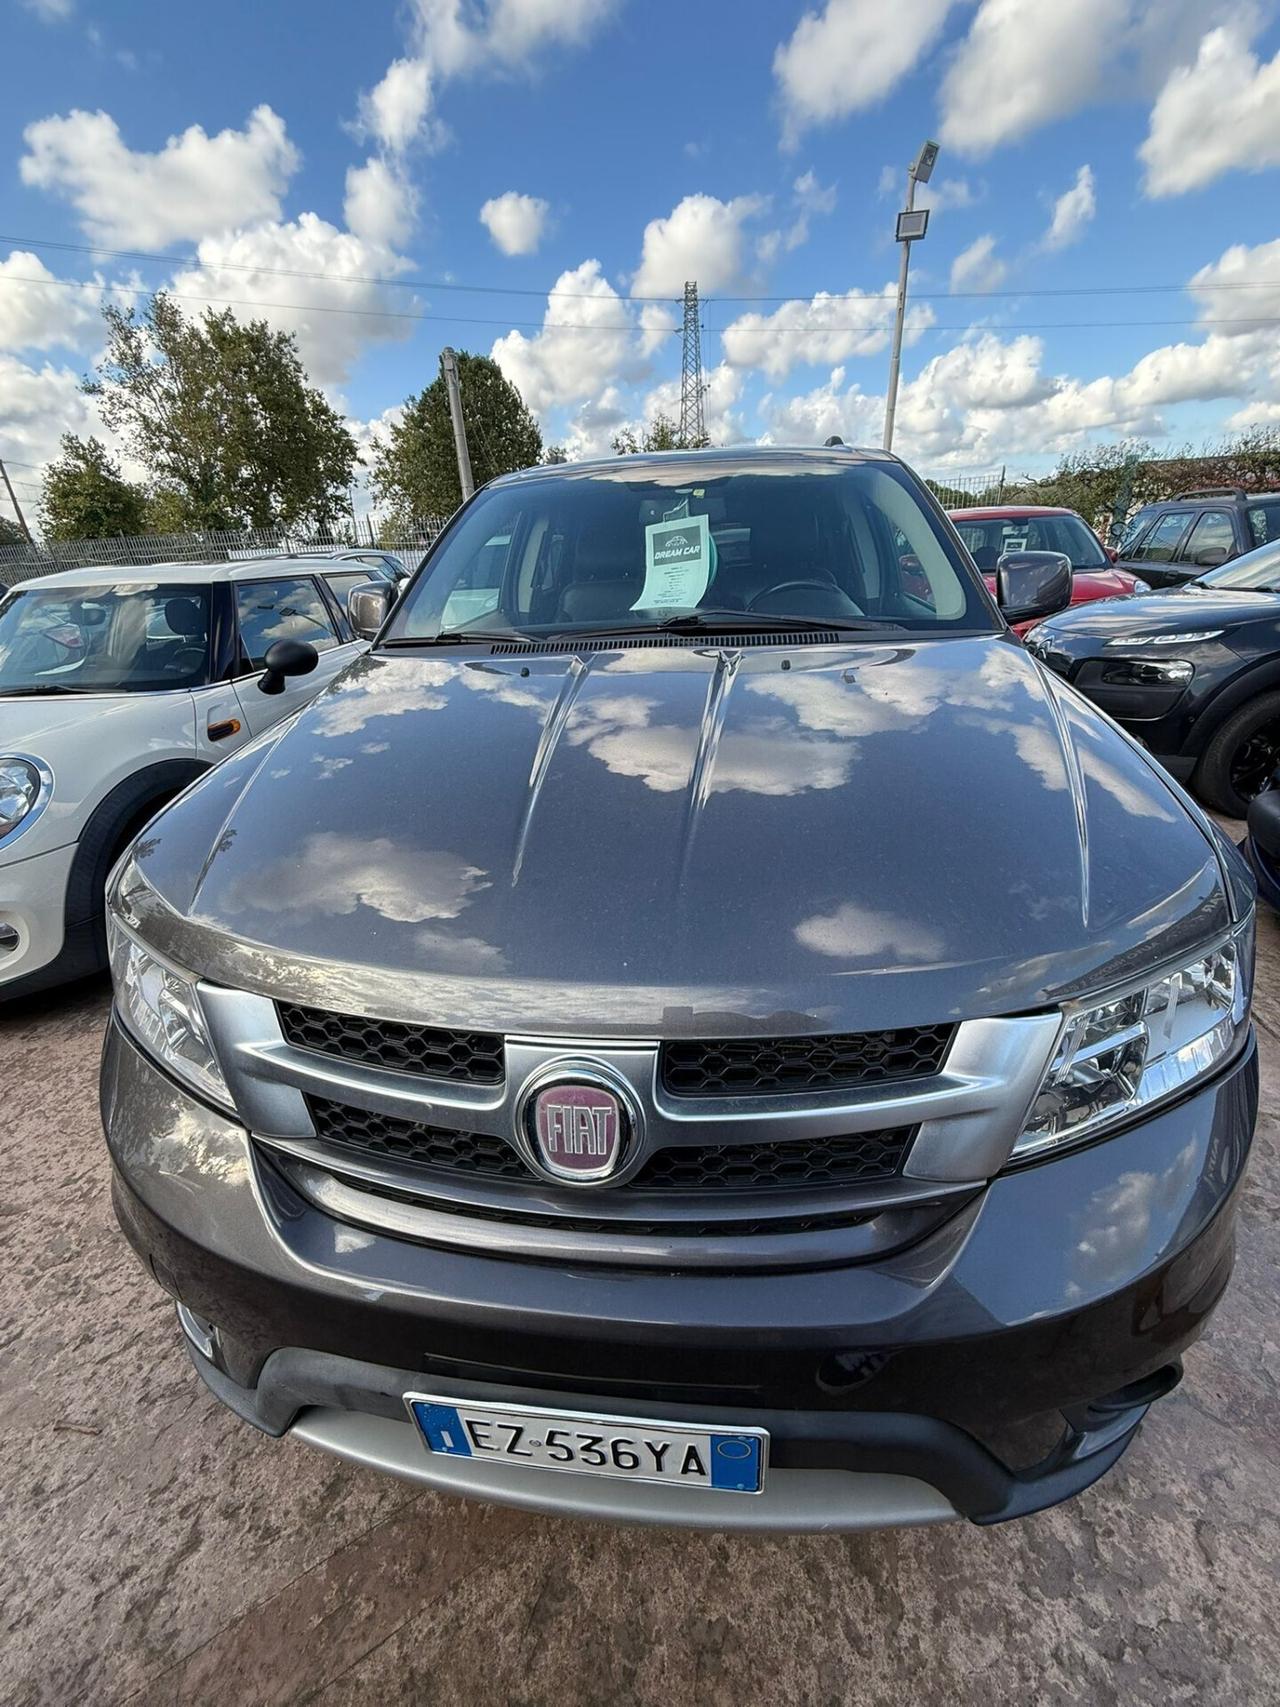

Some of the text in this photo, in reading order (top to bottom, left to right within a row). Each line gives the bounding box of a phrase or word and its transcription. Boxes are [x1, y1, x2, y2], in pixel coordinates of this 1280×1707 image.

[655, 545, 700, 560] DREAM CAR
[547, 1104, 612, 1155] FIAT
